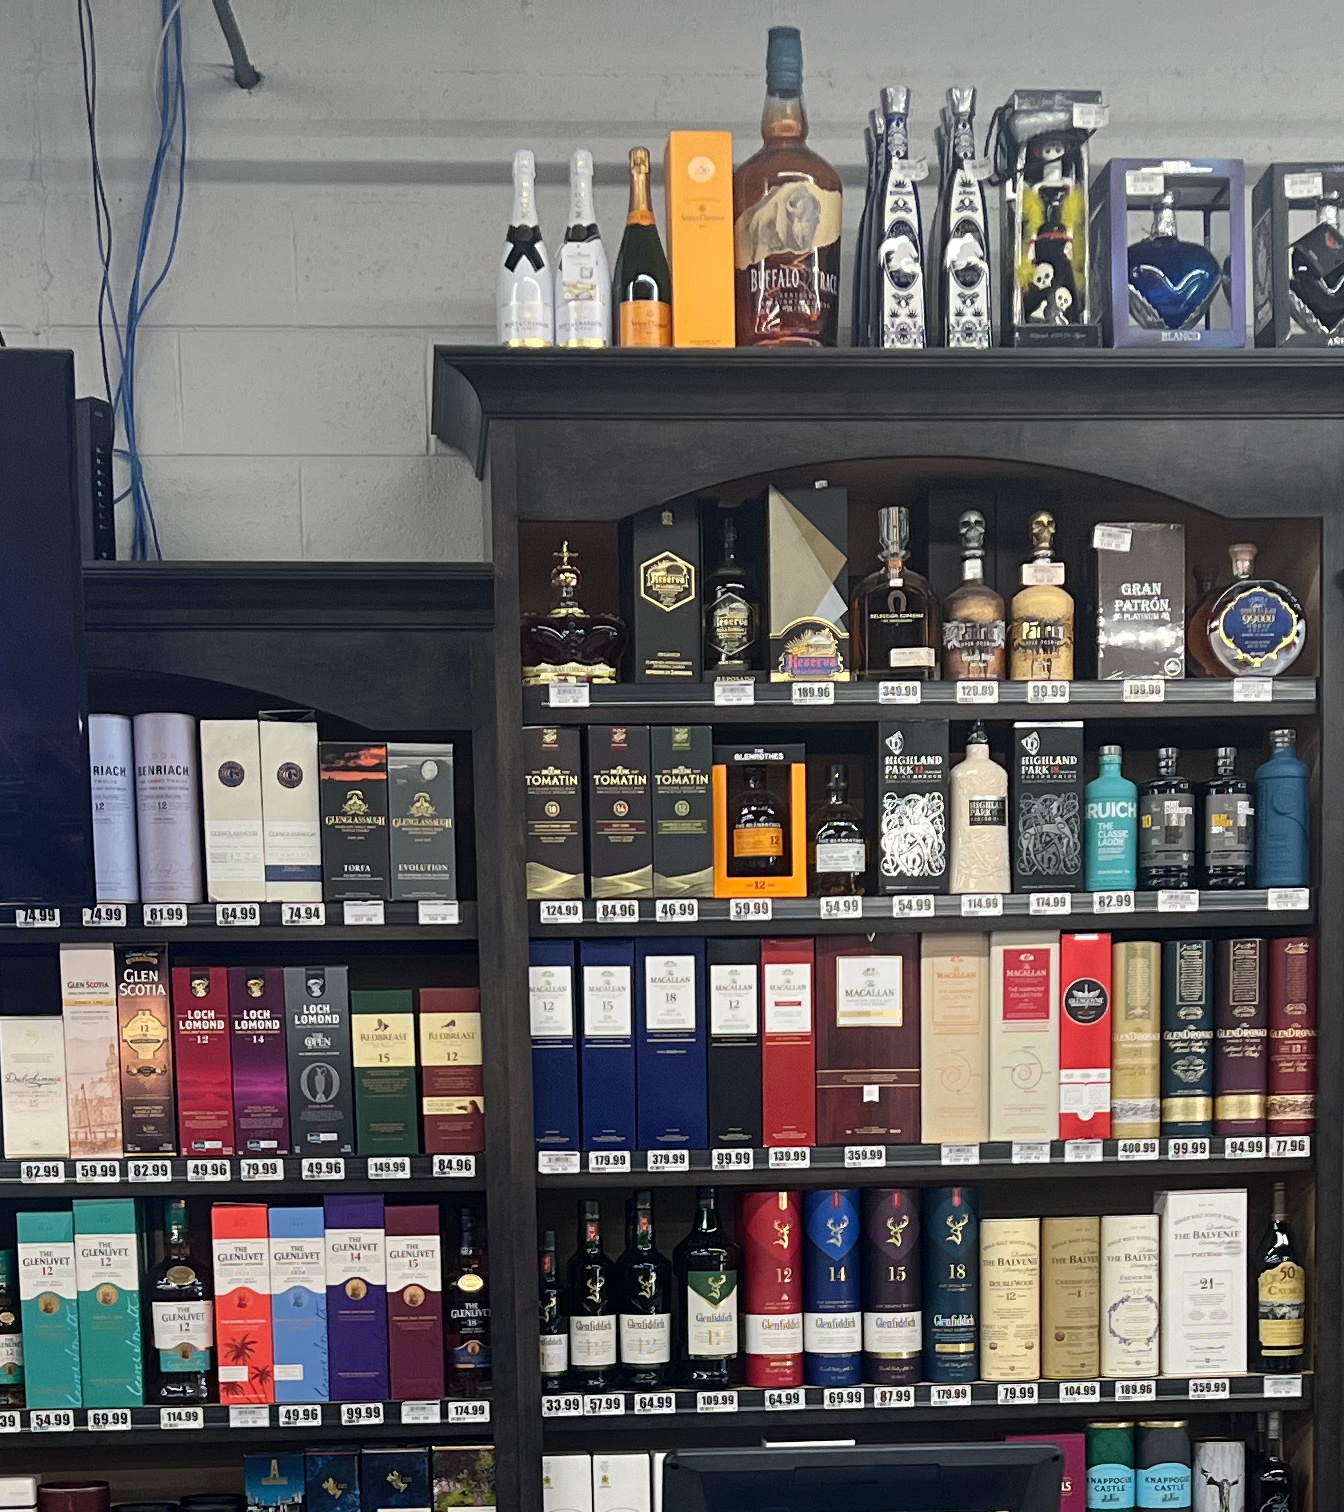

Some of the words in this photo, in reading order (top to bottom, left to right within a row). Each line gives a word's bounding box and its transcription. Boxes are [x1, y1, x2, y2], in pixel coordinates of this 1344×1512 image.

[751, 269, 799, 293] BUFFALO
[812, 269, 838, 293] TRACE
[1121, 583, 1161, 596] GRAN
[1021, 755, 1077, 765] HIGHLAND
[138, 765, 189, 777] BENRIACH
[525, 775, 578, 786] TOMATIN
[593, 775, 647, 786] TOMATIN
[655, 773, 708, 785] TOMATIN
[1098, 895, 1131, 907] 82.99
[602, 904, 635, 917] 84.96
[735, 903, 768, 915] 59.99
[123, 969, 159, 984] GLEN
[845, 988, 894, 997] MACALLAN
[243, 1009, 271, 1020] LOCH
[294, 1014, 340, 1025] LOMOND
[1275, 1139, 1305, 1152] 77.96
[274, 1252, 320, 1262] GLENLIVET
[390, 1250, 435, 1260] GLENLIVET
[829, 1267, 846, 1282] 14
[888, 1266, 906, 1281] 15
[1094, 1484, 1125, 1492] CASTLE
